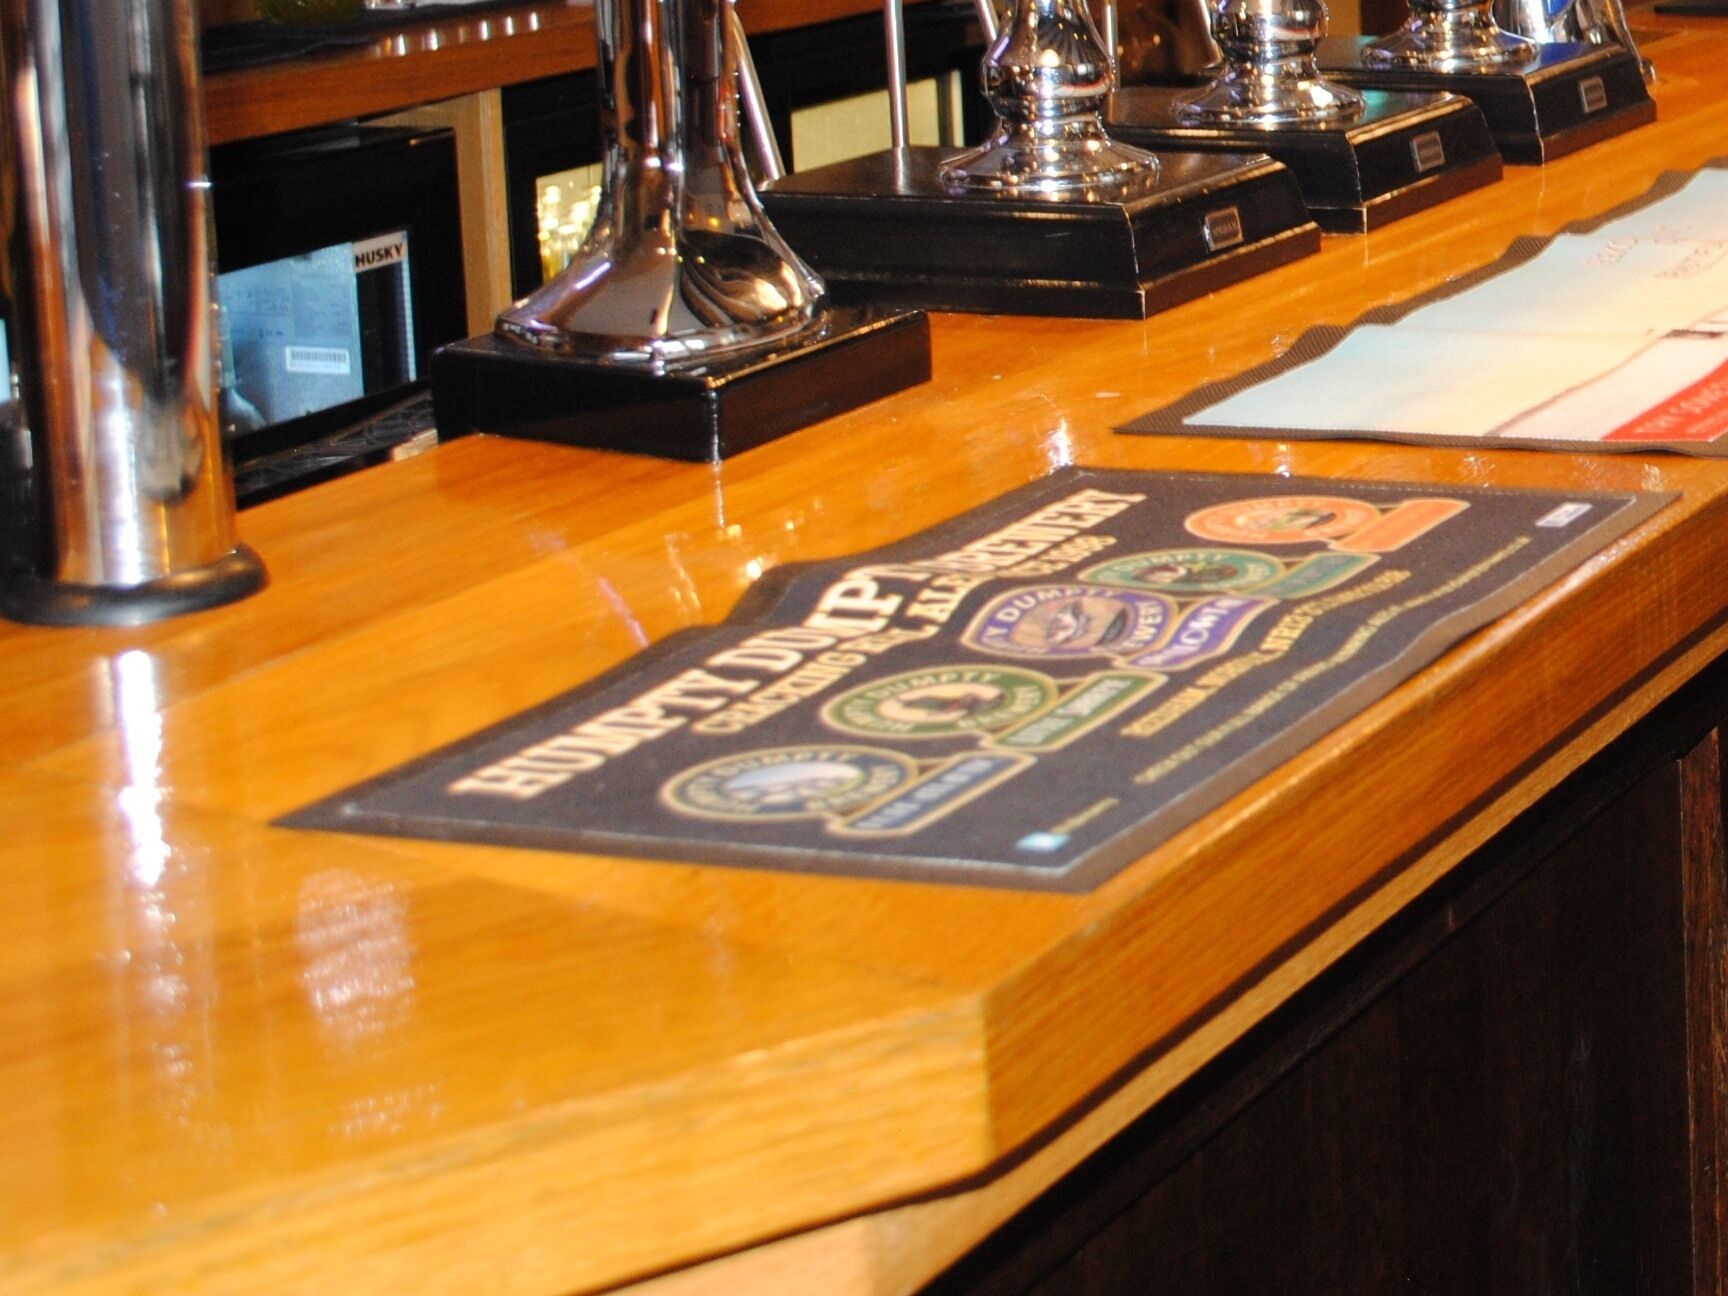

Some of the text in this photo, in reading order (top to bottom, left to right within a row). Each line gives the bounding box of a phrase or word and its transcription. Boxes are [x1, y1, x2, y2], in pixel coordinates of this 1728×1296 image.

[355, 242, 404, 268] HUSKY
[447, 667, 733, 800] HUMPTY
[704, 561, 945, 675] DUMPT
[691, 650, 868, 737] CRACKING
